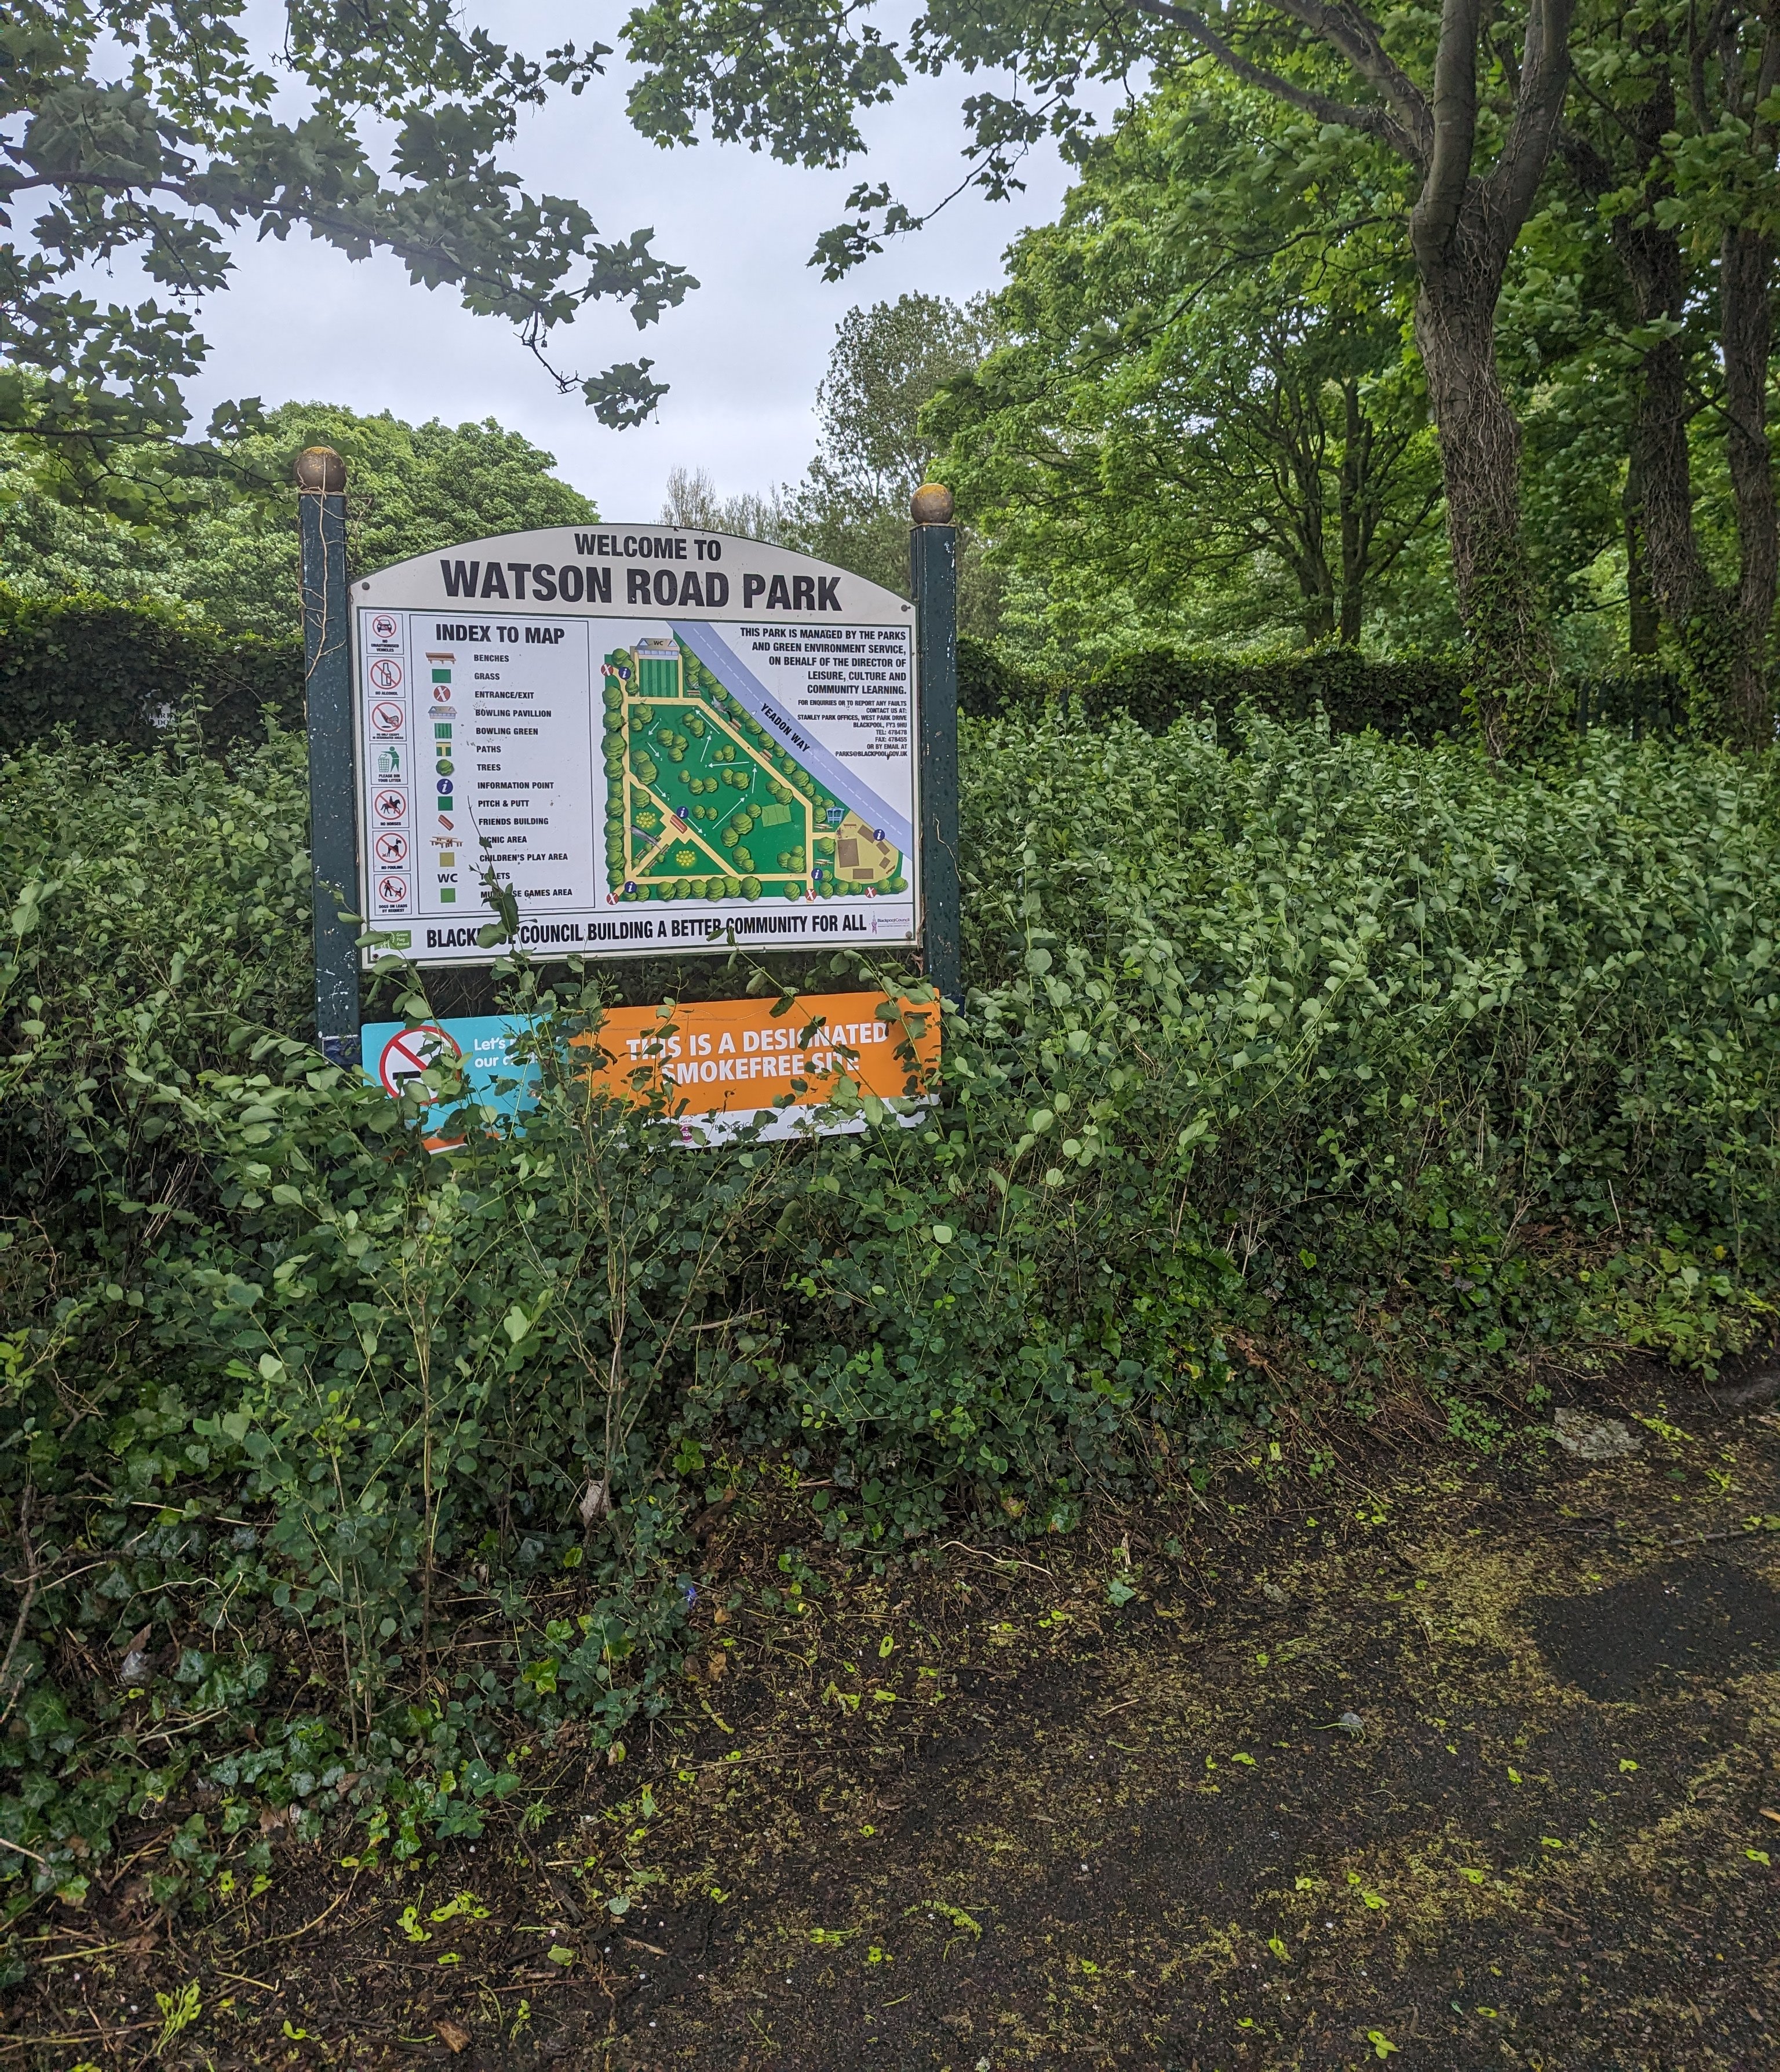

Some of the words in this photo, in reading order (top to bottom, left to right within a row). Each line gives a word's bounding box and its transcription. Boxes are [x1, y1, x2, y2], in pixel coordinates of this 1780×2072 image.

[575, 533, 687, 560] WELCOME
[694, 539, 721, 561] TO
[440, 560, 612, 604] WATSON
[627, 569, 728, 608] ROAD
[743, 574, 842, 611] PARK
[436, 623, 491, 642] INDEX
[497, 626, 519, 643] TO
[525, 627, 565, 644] MAP
[740, 628, 760, 637] THIS
[763, 628, 786, 637] PARK
[789, 629, 797, 638] IS
[800, 629, 842, 639] MANAGED
[845, 630, 856, 640] BY
[859, 631, 875, 640] THE
[877, 631, 906, 640] PARKS
[752, 642, 770, 651] AND
[773, 642, 801, 652] GREEN
[804, 643, 866, 653] ENVIRONMENT
[869, 644, 906, 655] SERVICE,
[473, 654, 509, 662] BENCHES
[769, 656, 781, 665] ON
[784, 656, 817, 666] BEHALF
[819, 657, 830, 666] OF
[833, 657, 849, 667] THE
[852, 658, 893, 667] DIRECTOR
[896, 658, 906, 667] OF
[474, 672, 500, 680] GRASS
[808, 670, 846, 682] LEISURE,
[848, 671, 887, 681] CULTURE
[889, 672, 906, 681] AND
[475, 691, 534, 699] ENTRANCE/EXIT
[807, 684, 859, 694] COMMUNITY
[862, 685, 907, 695] LEARNING.
[761, 703, 792, 736] YEADON
[790, 732, 810, 752] WAY
[437, 873, 458, 883] WC
[426, 928, 516, 948] BLACKL
[521, 924, 583, 944] COUNCIL
[588, 920, 653, 941] BUILDING
[657, 920, 668, 937] A
[672, 918, 722, 937] BETTER
[726, 915, 808, 935] COMMUNITY
[812, 915, 838, 932] FOR
[842, 914, 867, 932] ALL
[474, 1037, 506, 1051] Let's
[626, 1036, 681, 1061] THIS
[690, 1034, 712, 1056] IS
[718, 1032, 736, 1054] A
[475, 1057, 499, 1068] our
[662, 1053, 805, 1085] SMOKEFREE
